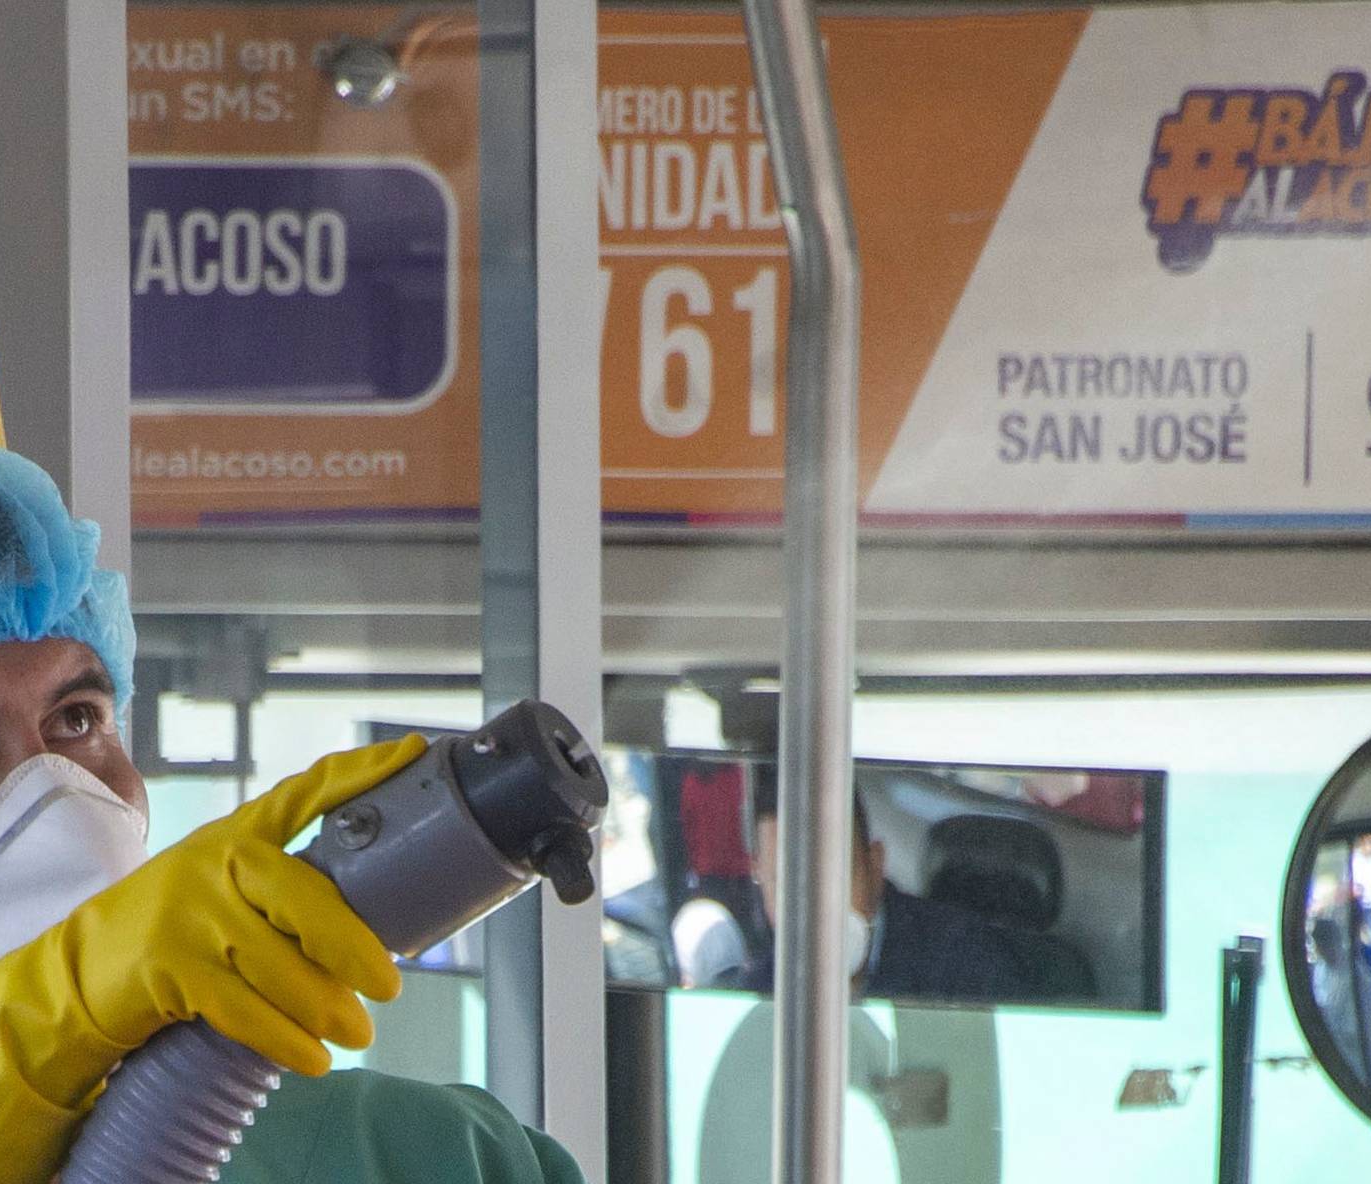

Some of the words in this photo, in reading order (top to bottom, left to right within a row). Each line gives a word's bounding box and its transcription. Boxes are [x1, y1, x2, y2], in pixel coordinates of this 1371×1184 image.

[237, 39, 298, 73] en
[182, 80, 296, 123] SMS:
[692, 87, 738, 135] DE
[132, 209, 347, 297] ACOSO
[599, 262, 778, 439] 61
[996, 352, 1250, 401] PATRONATO
[996, 411, 1102, 465] SAN
[1118, 402, 1248, 465] JOSÉ
